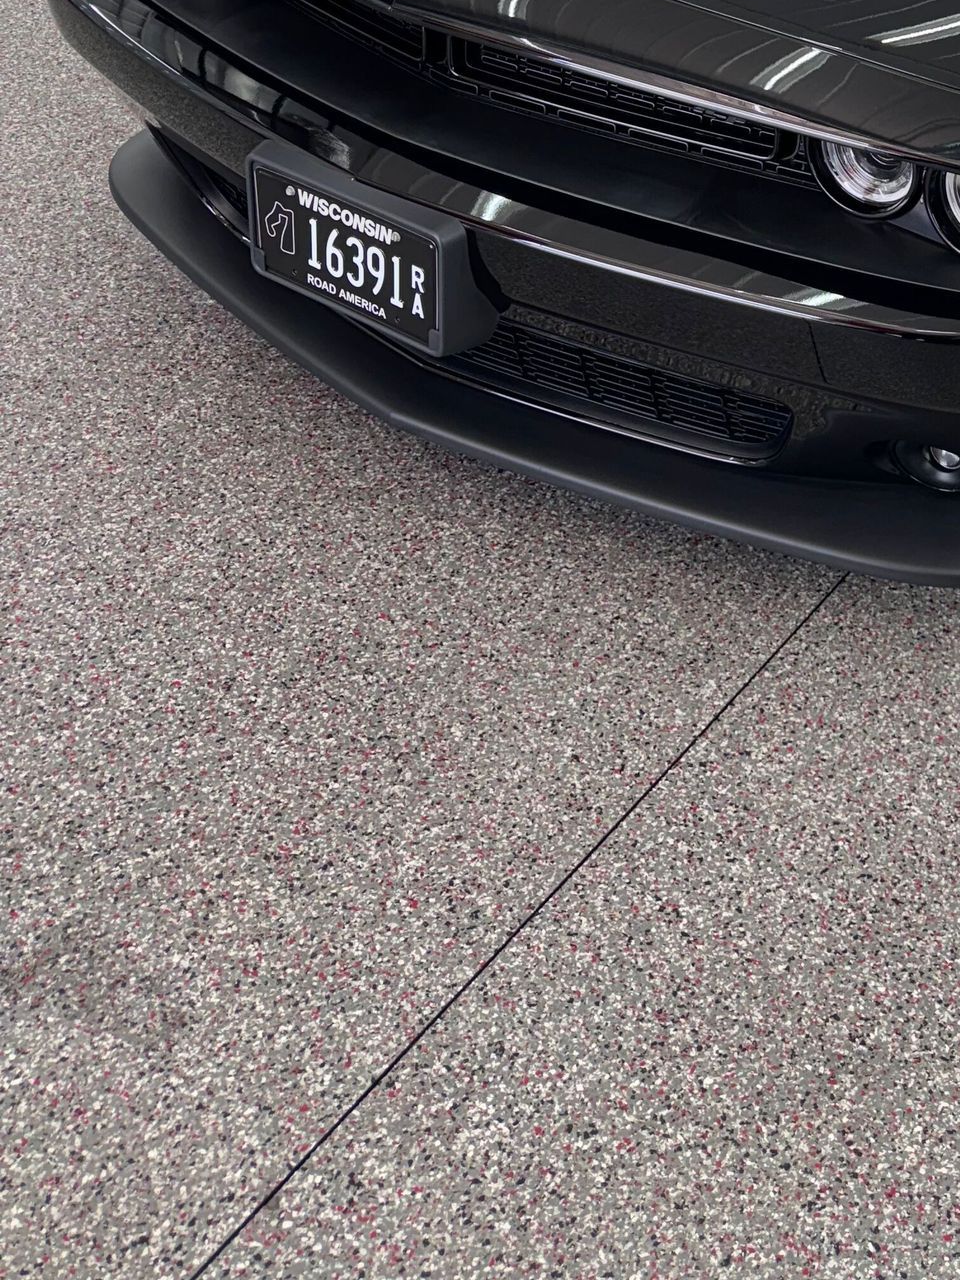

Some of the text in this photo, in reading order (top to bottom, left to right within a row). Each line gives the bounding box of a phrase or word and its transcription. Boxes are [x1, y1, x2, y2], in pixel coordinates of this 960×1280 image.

[297, 188, 393, 245] WISCONSIN
[307, 218, 404, 309] 16391
[306, 272, 387, 320] ROAD AMERICA
